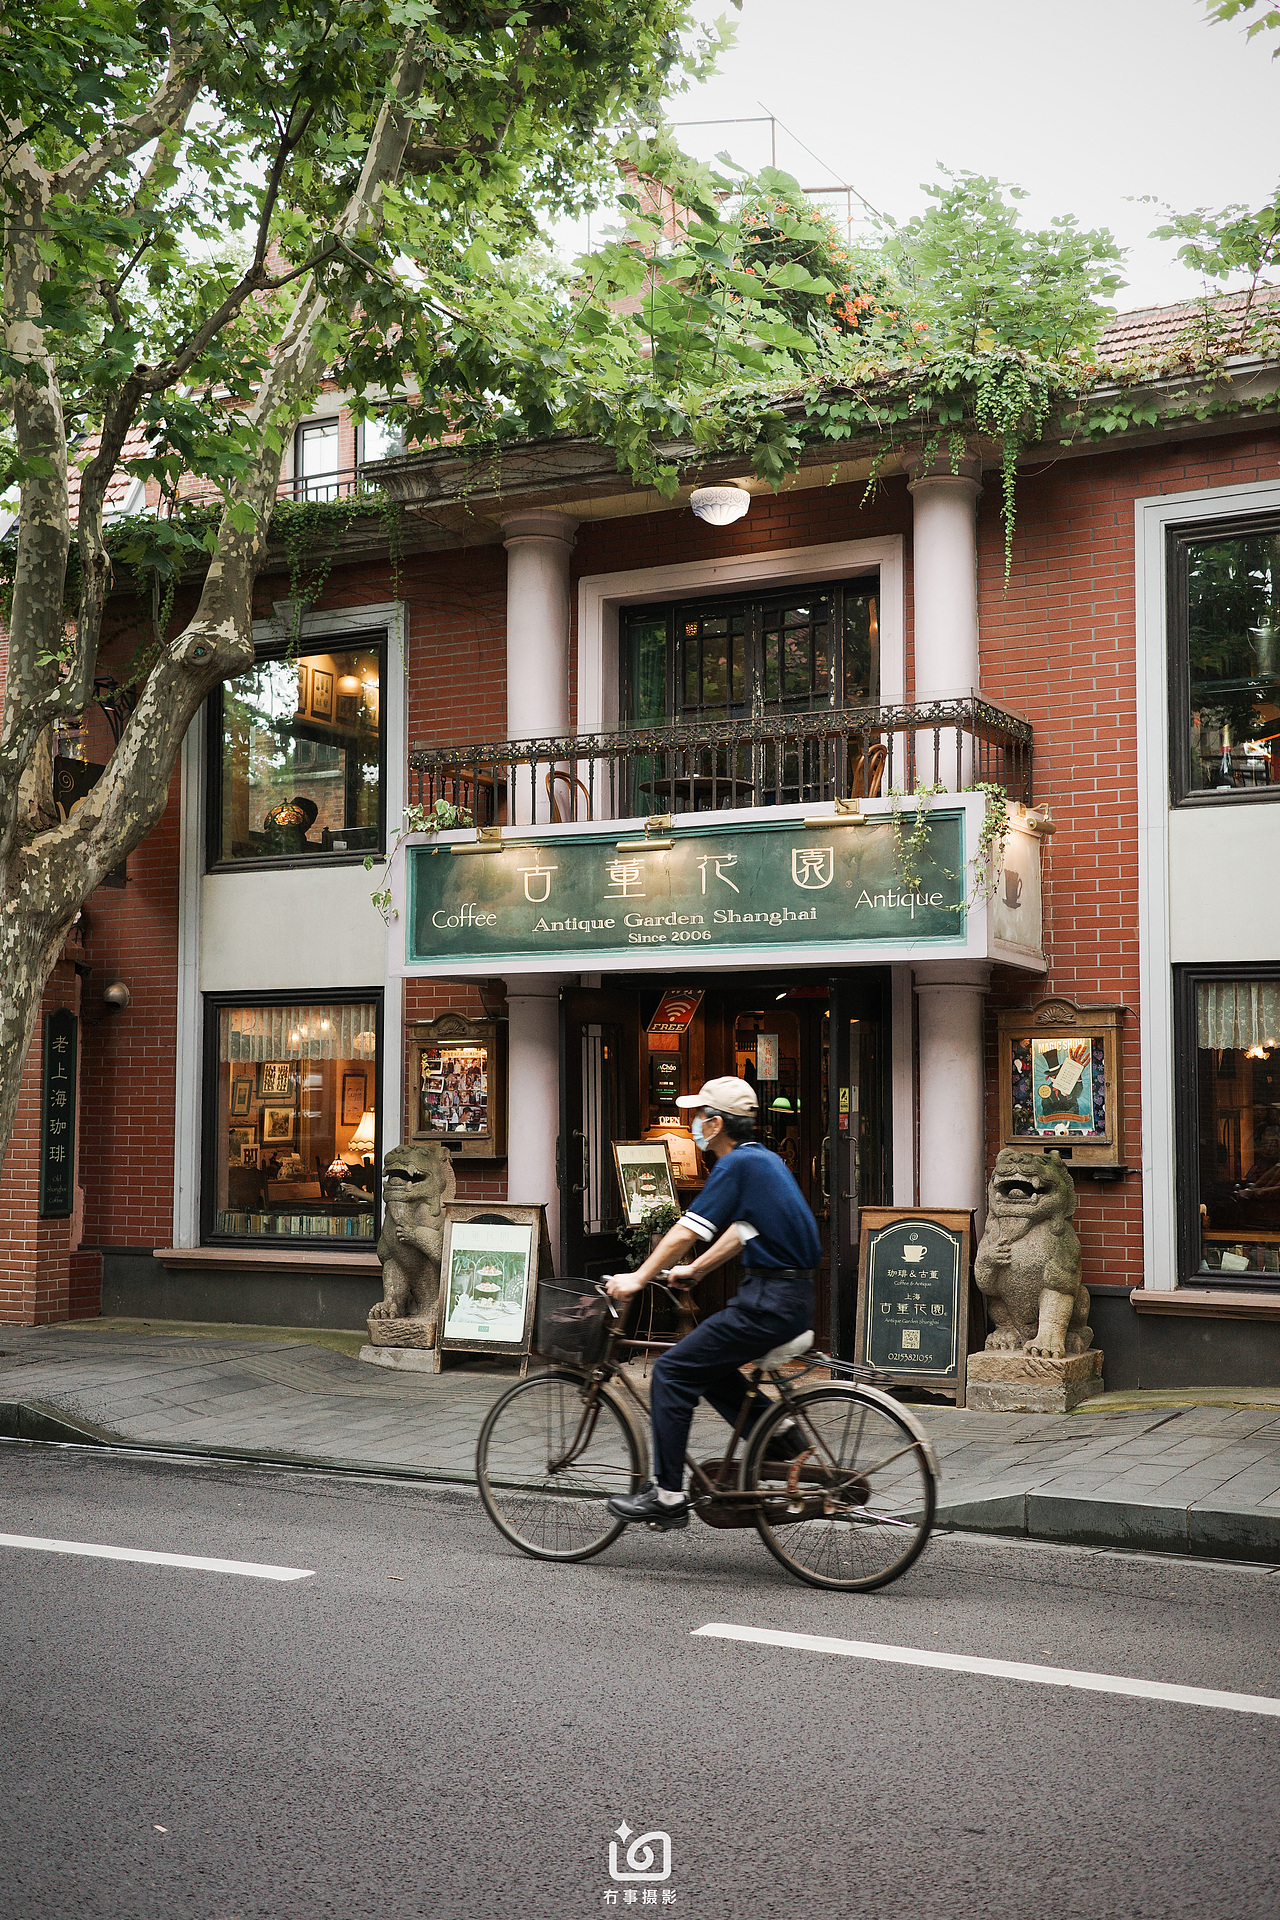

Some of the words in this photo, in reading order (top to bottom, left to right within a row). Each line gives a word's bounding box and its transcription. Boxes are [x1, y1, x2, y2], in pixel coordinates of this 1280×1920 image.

[515, 845, 836, 903] 古董花園
[853, 887, 944, 919] Antique
[431, 901, 498, 930] Coffee
[532, 914, 615, 934] Antique
[623, 911, 705, 929] Garden
[713, 906, 818, 927] Shanghai
[628, 933, 667, 944] Since
[671, 930, 712, 941] 2006
[651, 1023, 685, 1031] FREE
[1038, 1041, 1062, 1054] MAGIC
[1062, 1038, 1085, 1051] SHOW
[49, 1035, 69, 1163] 老上海珈琲
[659, 1116, 680, 1124] OPEN
[909, 1269, 917, 1278] &
[904, 1293, 921, 1301] 上海
